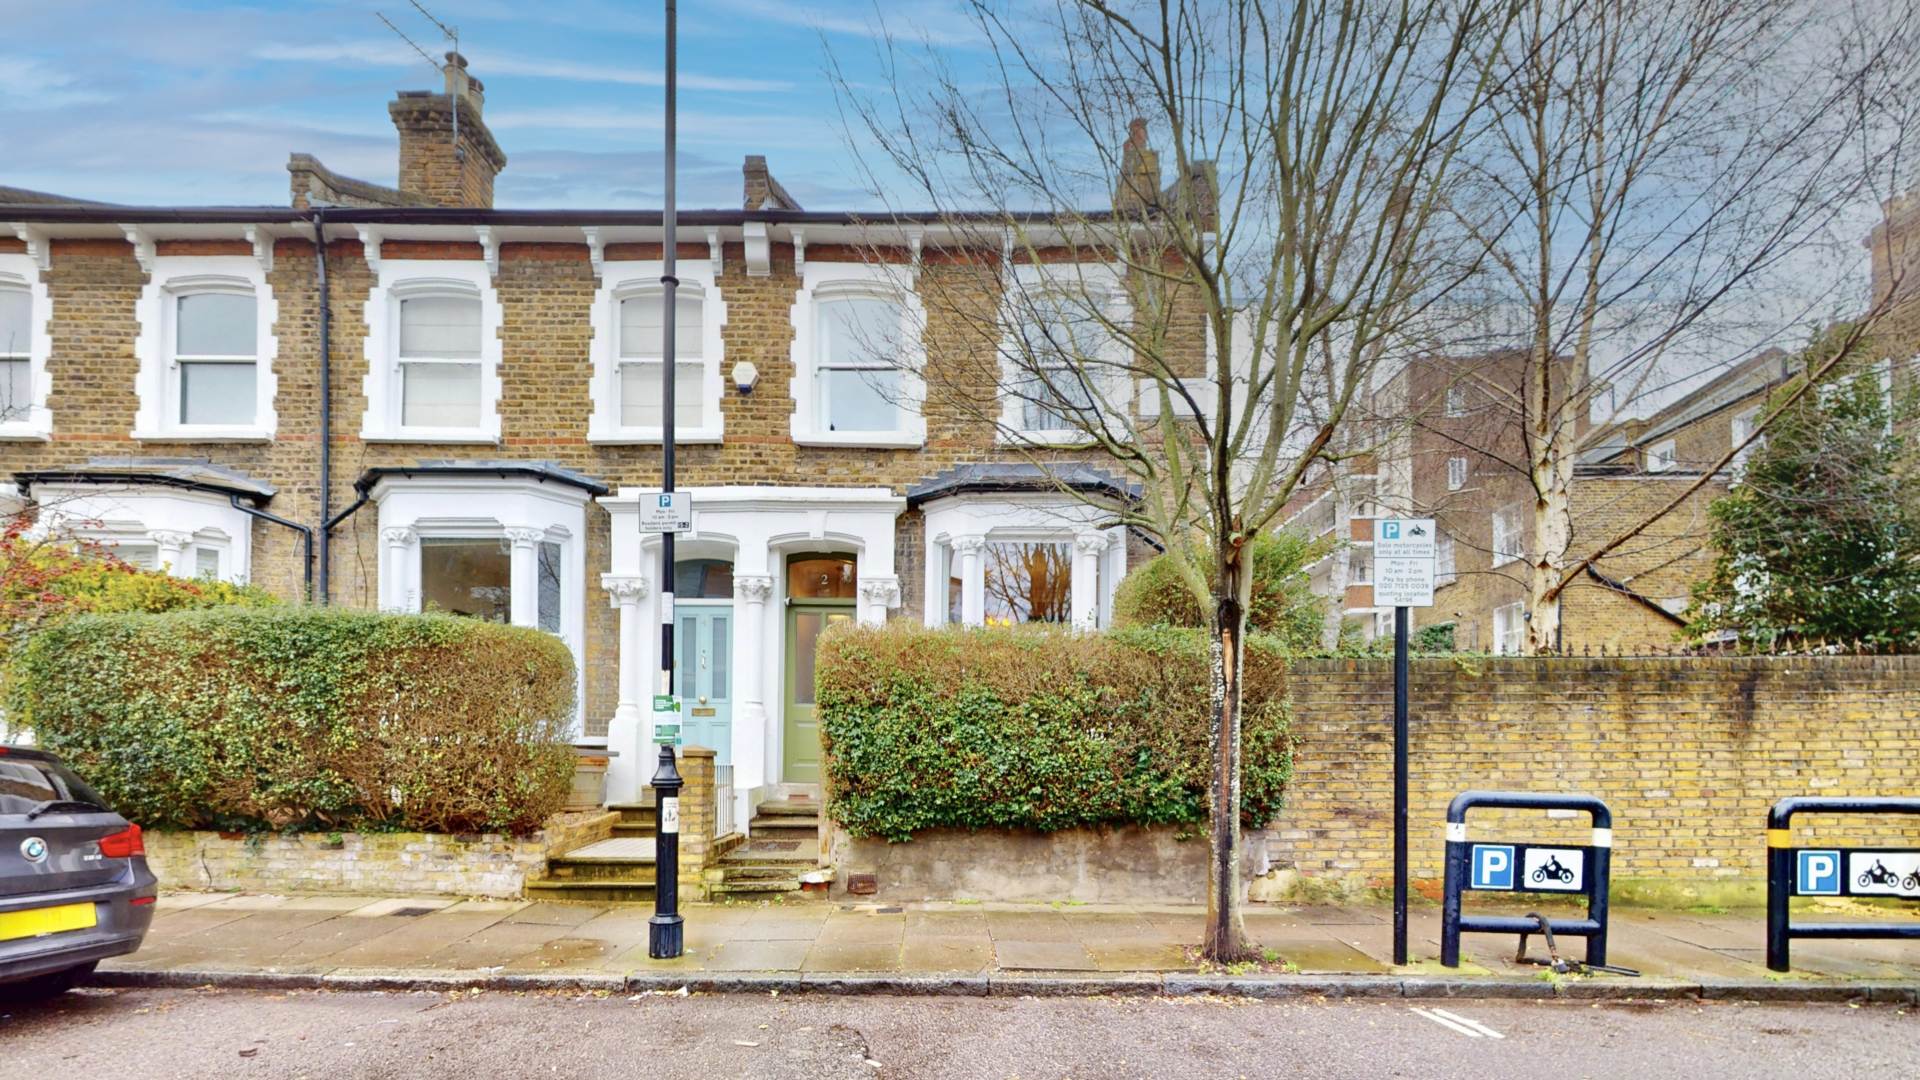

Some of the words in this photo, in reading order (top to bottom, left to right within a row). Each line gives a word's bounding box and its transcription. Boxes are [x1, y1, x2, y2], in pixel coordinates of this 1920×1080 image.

[662, 496, 670, 507] P
[1386, 524, 1398, 538] P
[821, 574, 829, 585] 2
[1482, 850, 1507, 884] P
[1808, 855, 1833, 890] P
